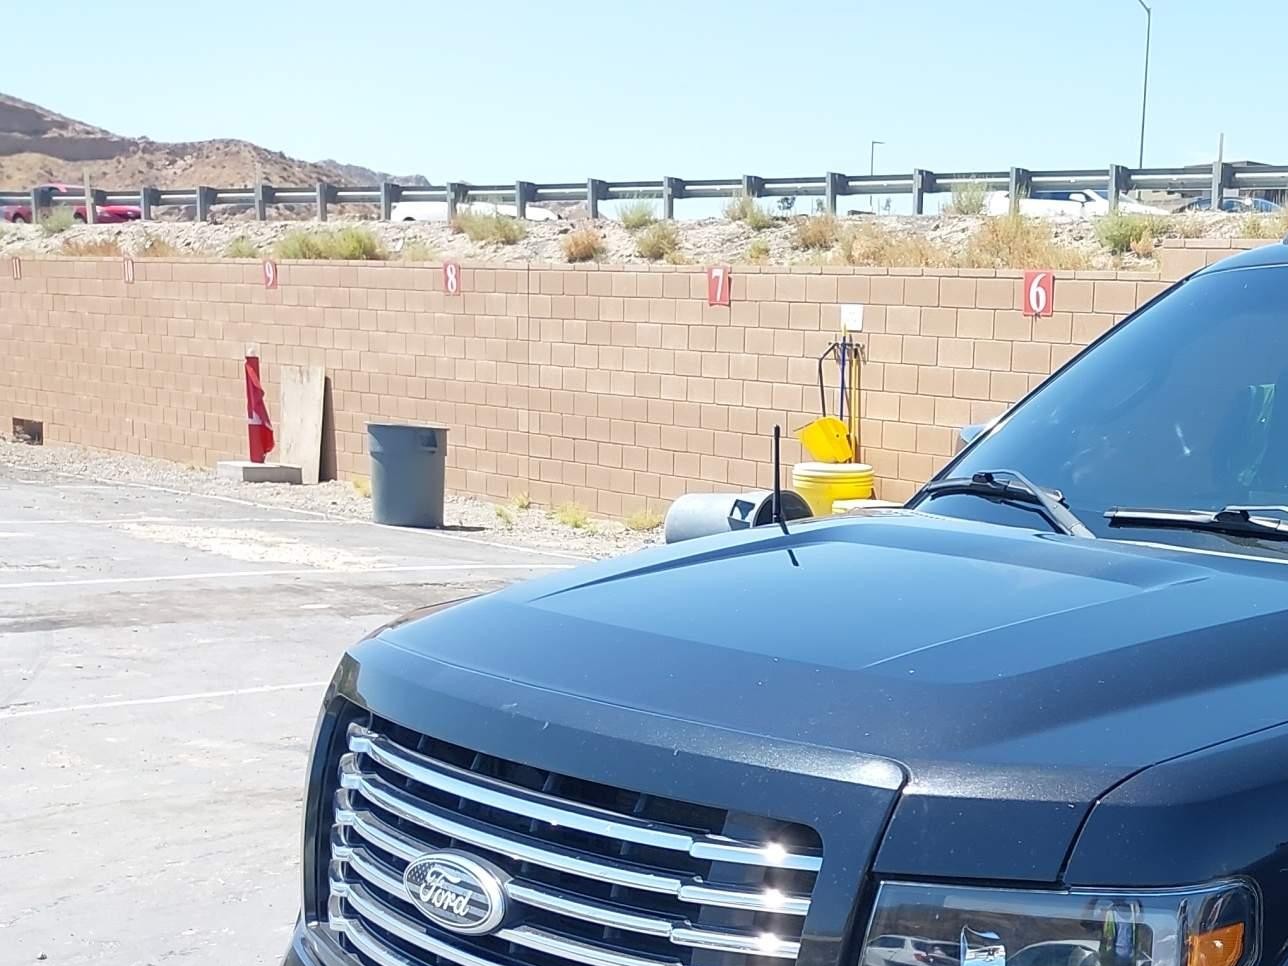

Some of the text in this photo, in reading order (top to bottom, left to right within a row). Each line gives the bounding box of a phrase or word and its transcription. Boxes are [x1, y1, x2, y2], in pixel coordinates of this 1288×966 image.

[264, 261, 274, 286] 9
[446, 264, 457, 292] 8
[711, 268, 724, 302] 7
[1029, 271, 1047, 313] 6
[419, 867, 473, 916] Ford
